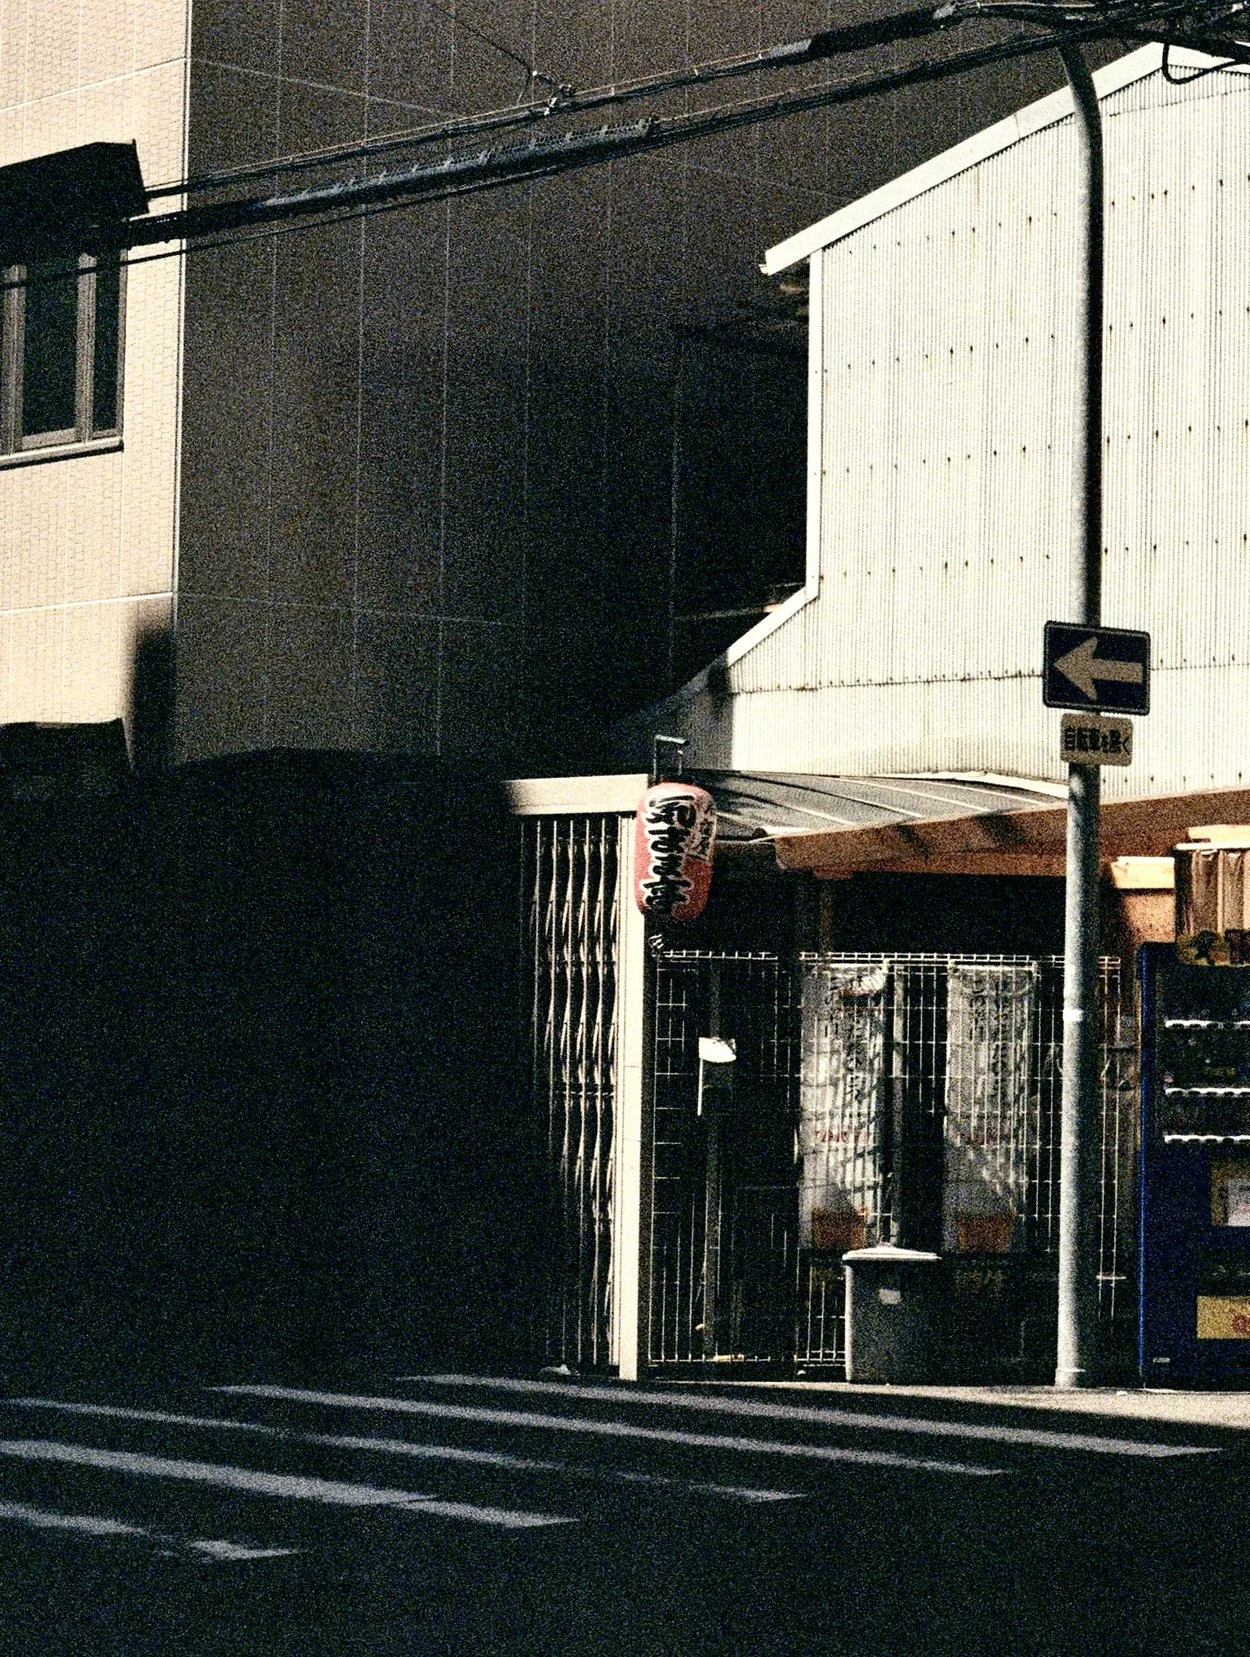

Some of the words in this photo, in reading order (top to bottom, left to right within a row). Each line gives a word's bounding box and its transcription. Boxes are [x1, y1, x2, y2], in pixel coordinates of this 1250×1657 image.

[1065, 726, 1131, 756] 自転車を除く
